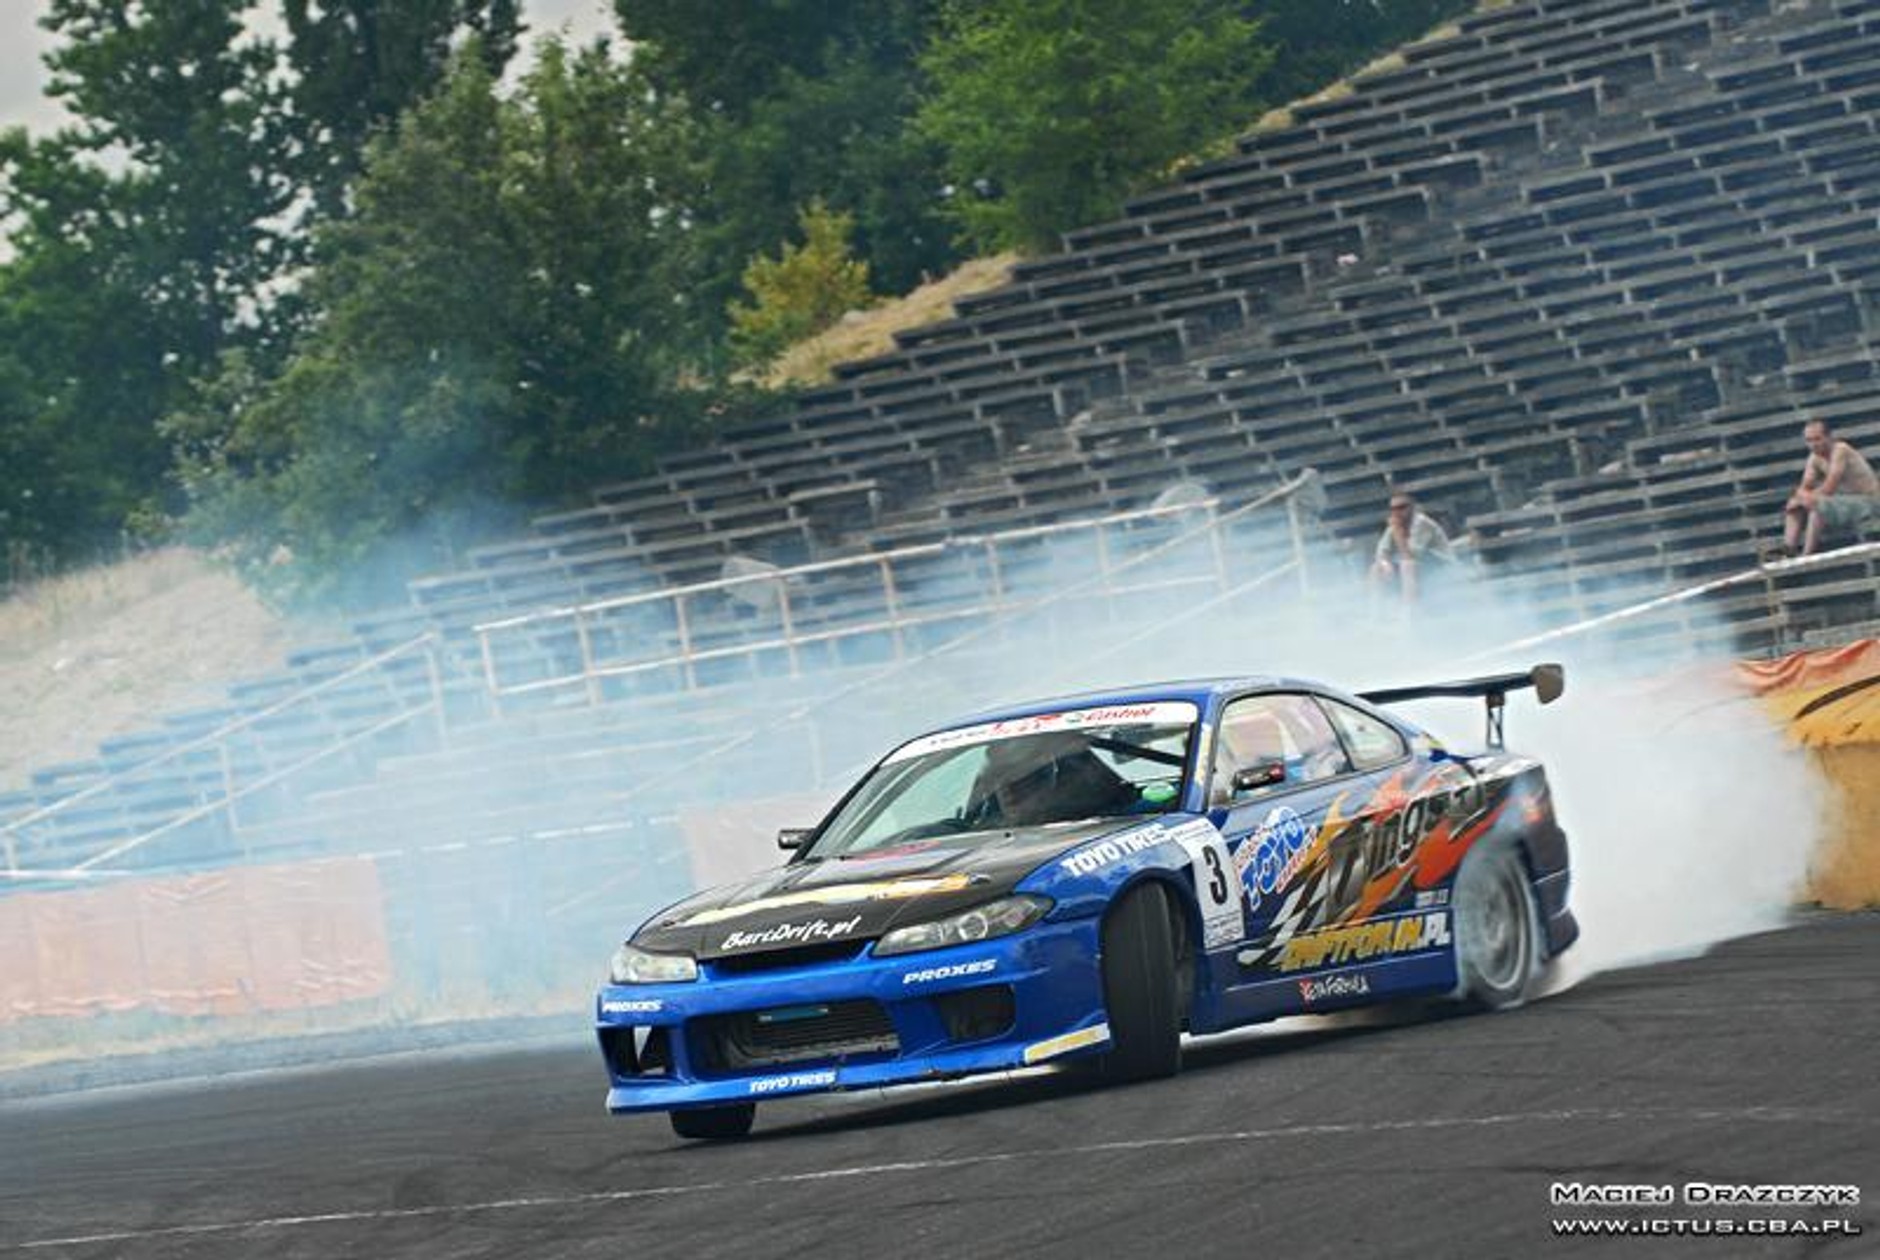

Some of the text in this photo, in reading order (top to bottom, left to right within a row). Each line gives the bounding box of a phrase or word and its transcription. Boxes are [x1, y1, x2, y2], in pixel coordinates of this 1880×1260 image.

[1060, 840, 1122, 877] TOYO
[1116, 823, 1172, 855] TIRES
[1201, 844, 1229, 906] 3
[903, 958, 998, 985] PROXES
[601, 1000, 664, 1014] PROXES
[749, 1071, 837, 1093] TOYO TIRES
